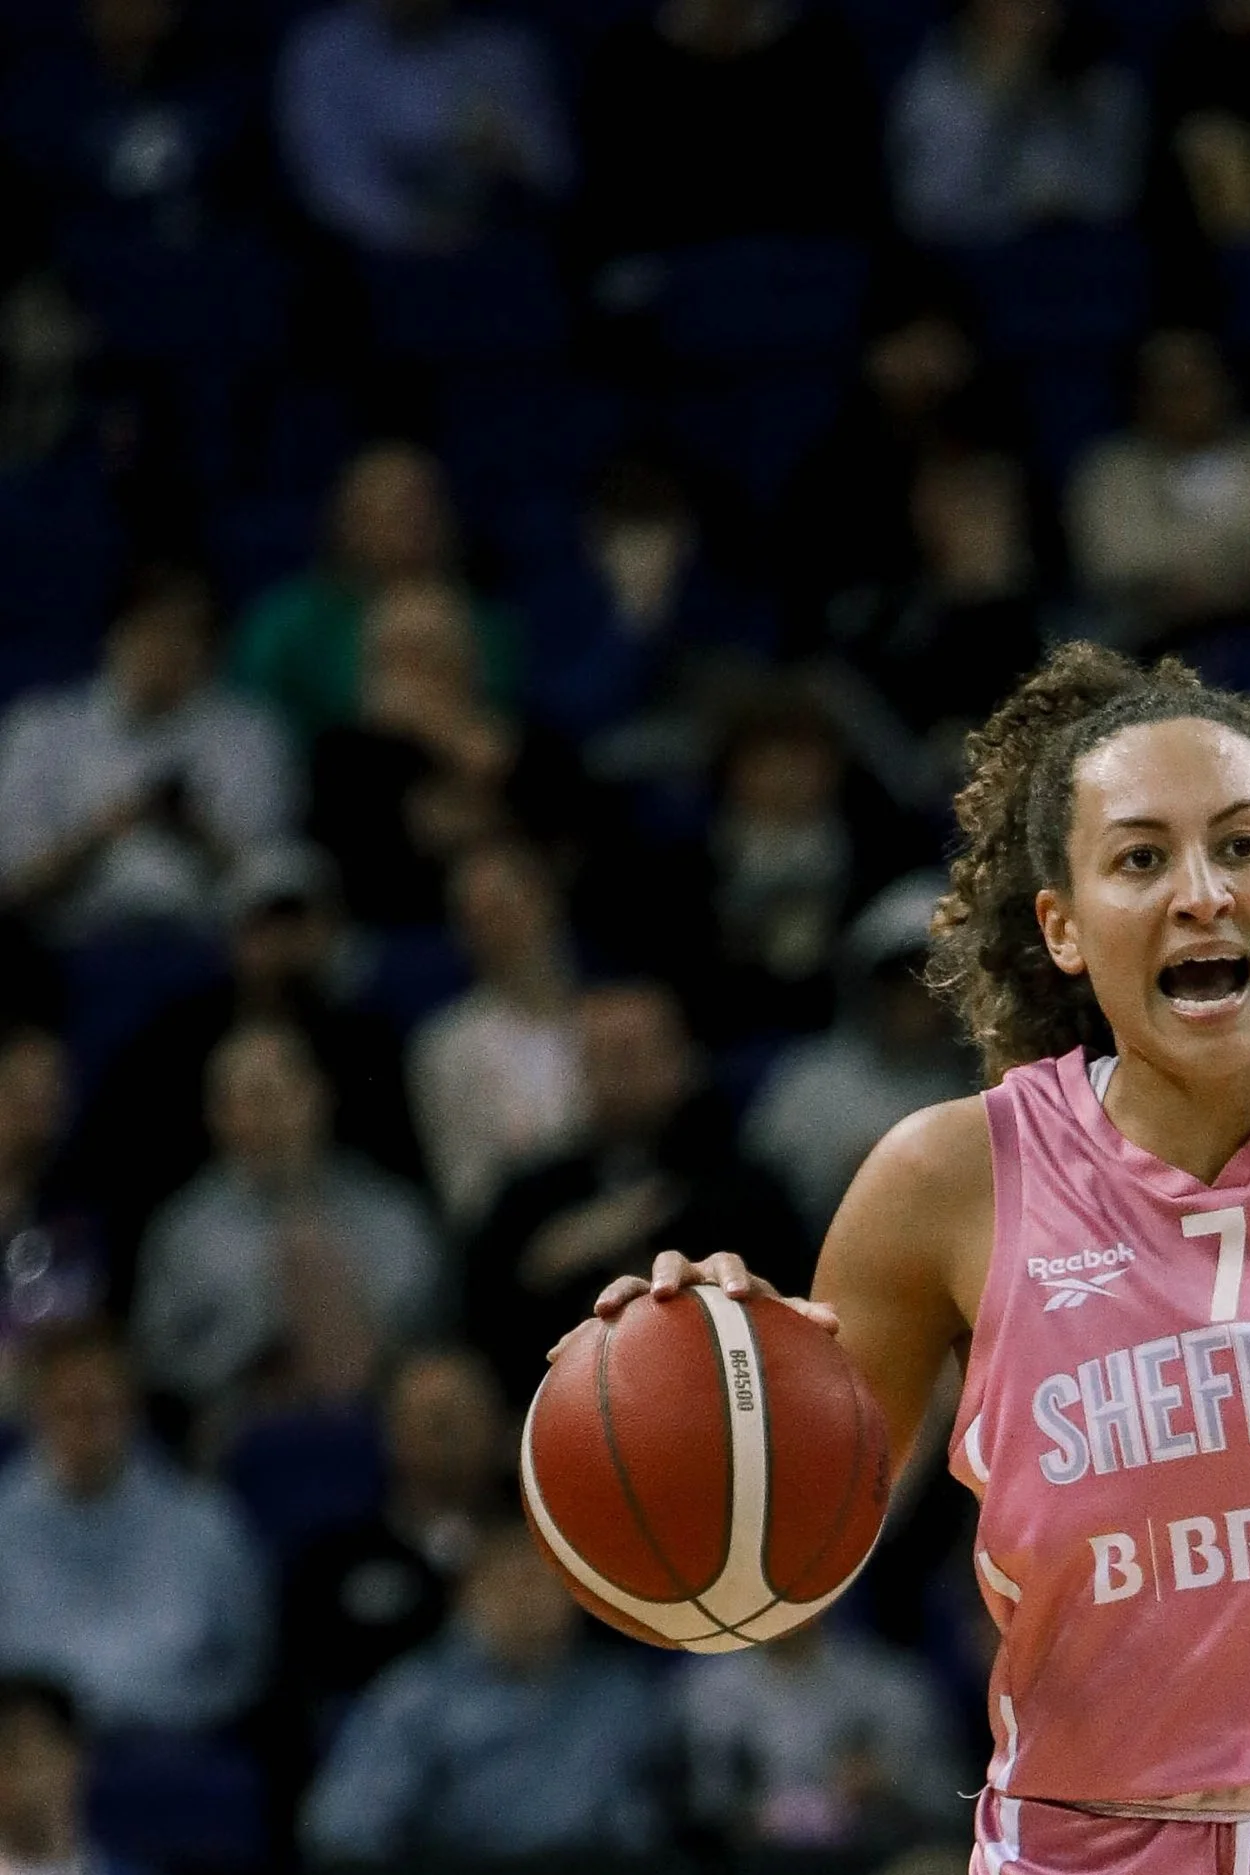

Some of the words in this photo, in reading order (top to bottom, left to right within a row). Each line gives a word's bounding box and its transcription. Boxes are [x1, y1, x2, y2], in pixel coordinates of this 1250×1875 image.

[1027, 1243, 1136, 1280] Reebok
[1181, 1206, 1247, 1322] 7
[729, 1350, 755, 1411] BG4500
